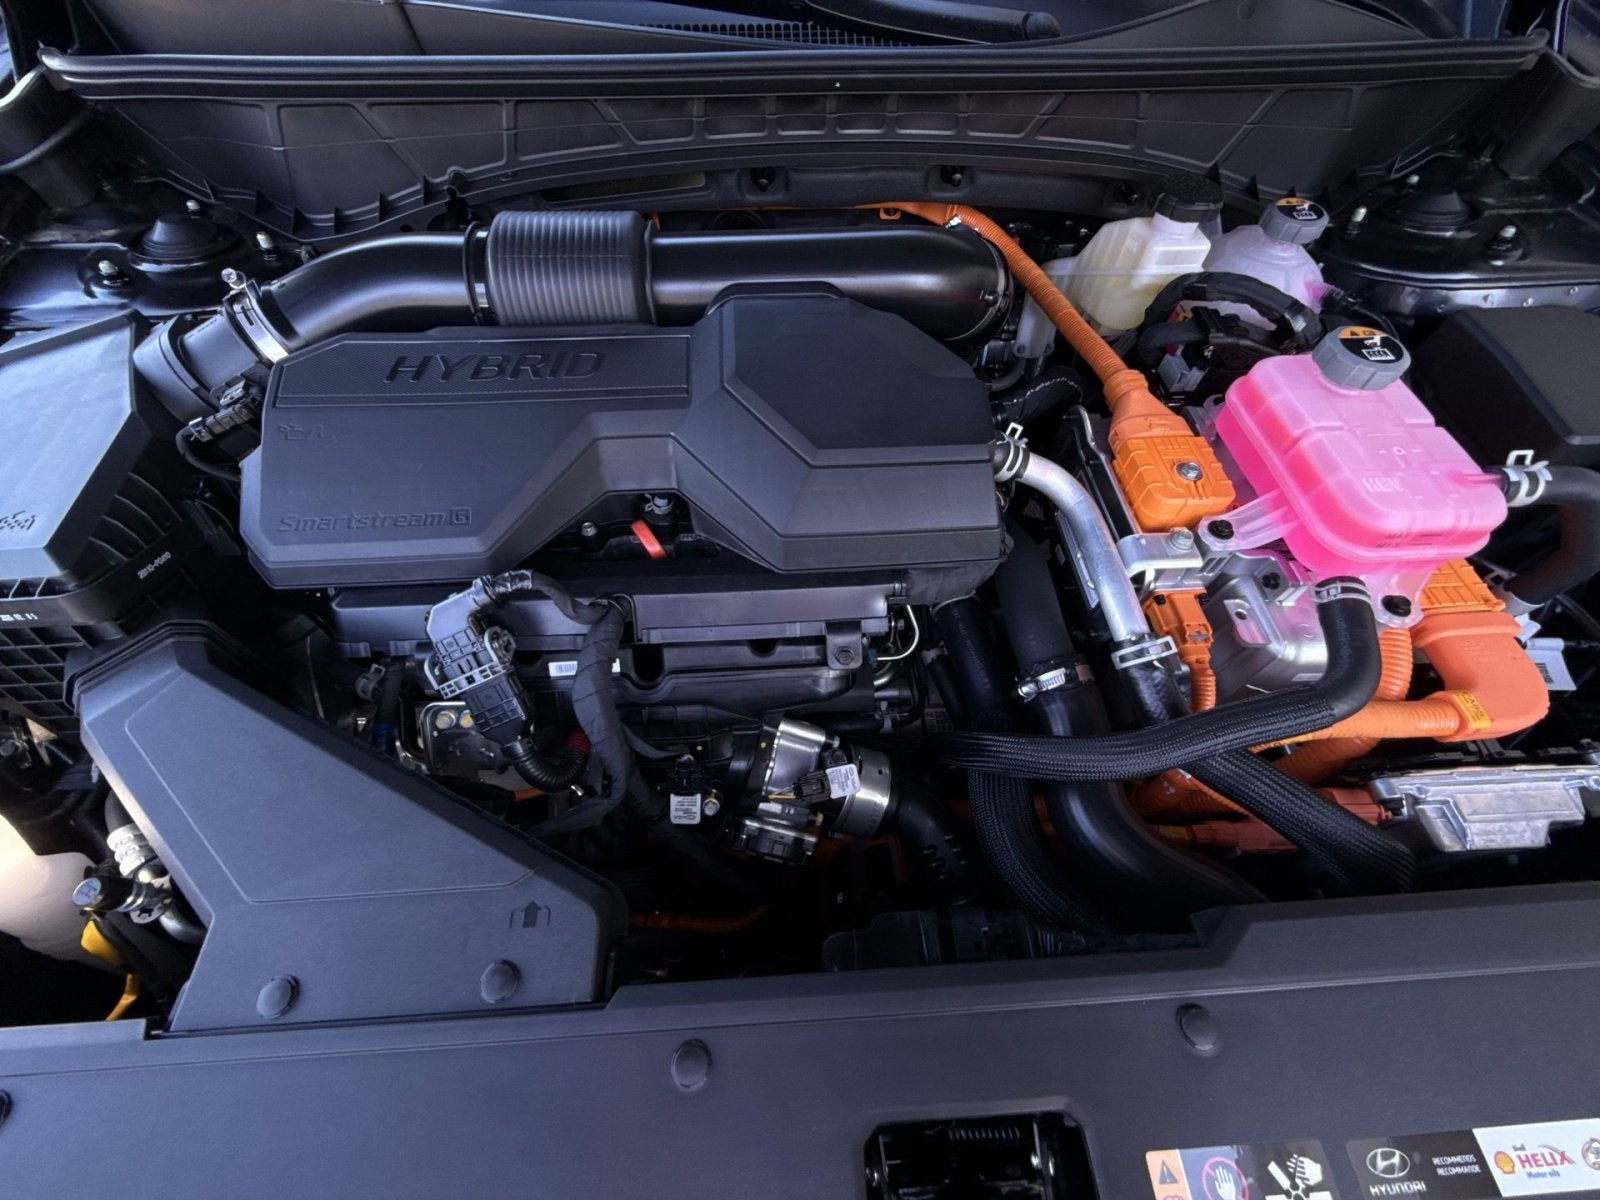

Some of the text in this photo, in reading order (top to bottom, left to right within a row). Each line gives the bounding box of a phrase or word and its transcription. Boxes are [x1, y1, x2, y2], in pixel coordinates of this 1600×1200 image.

[383, 353, 604, 383] HYBRID
[276, 512, 446, 532] Smartstream
[1432, 1154, 1476, 1166] RECOMMENDS
[1516, 1150, 1569, 1169] HELIX
[1527, 1170, 1548, 1179] Motor
[1369, 1180, 1427, 1197] HYUNDAI
